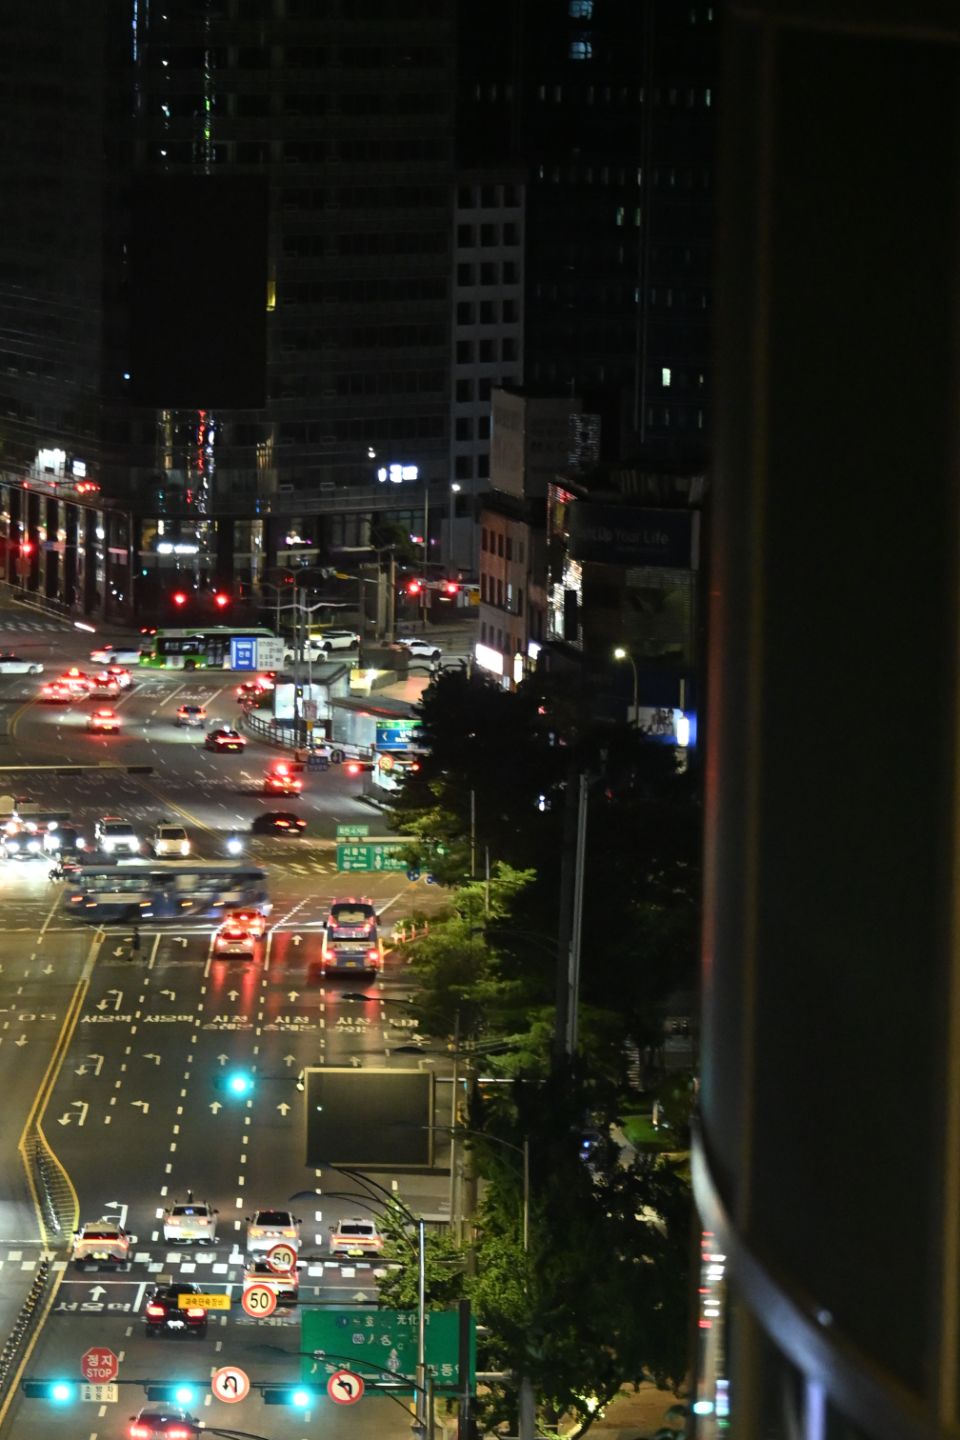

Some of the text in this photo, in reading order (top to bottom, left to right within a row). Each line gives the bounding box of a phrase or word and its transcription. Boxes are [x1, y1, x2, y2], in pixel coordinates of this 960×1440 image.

[273, 1252, 291, 1266] 50
[250, 1293, 269, 1309] 50
[87, 1354, 113, 1367] 정지
[86, 1368, 113, 1378] STOP
